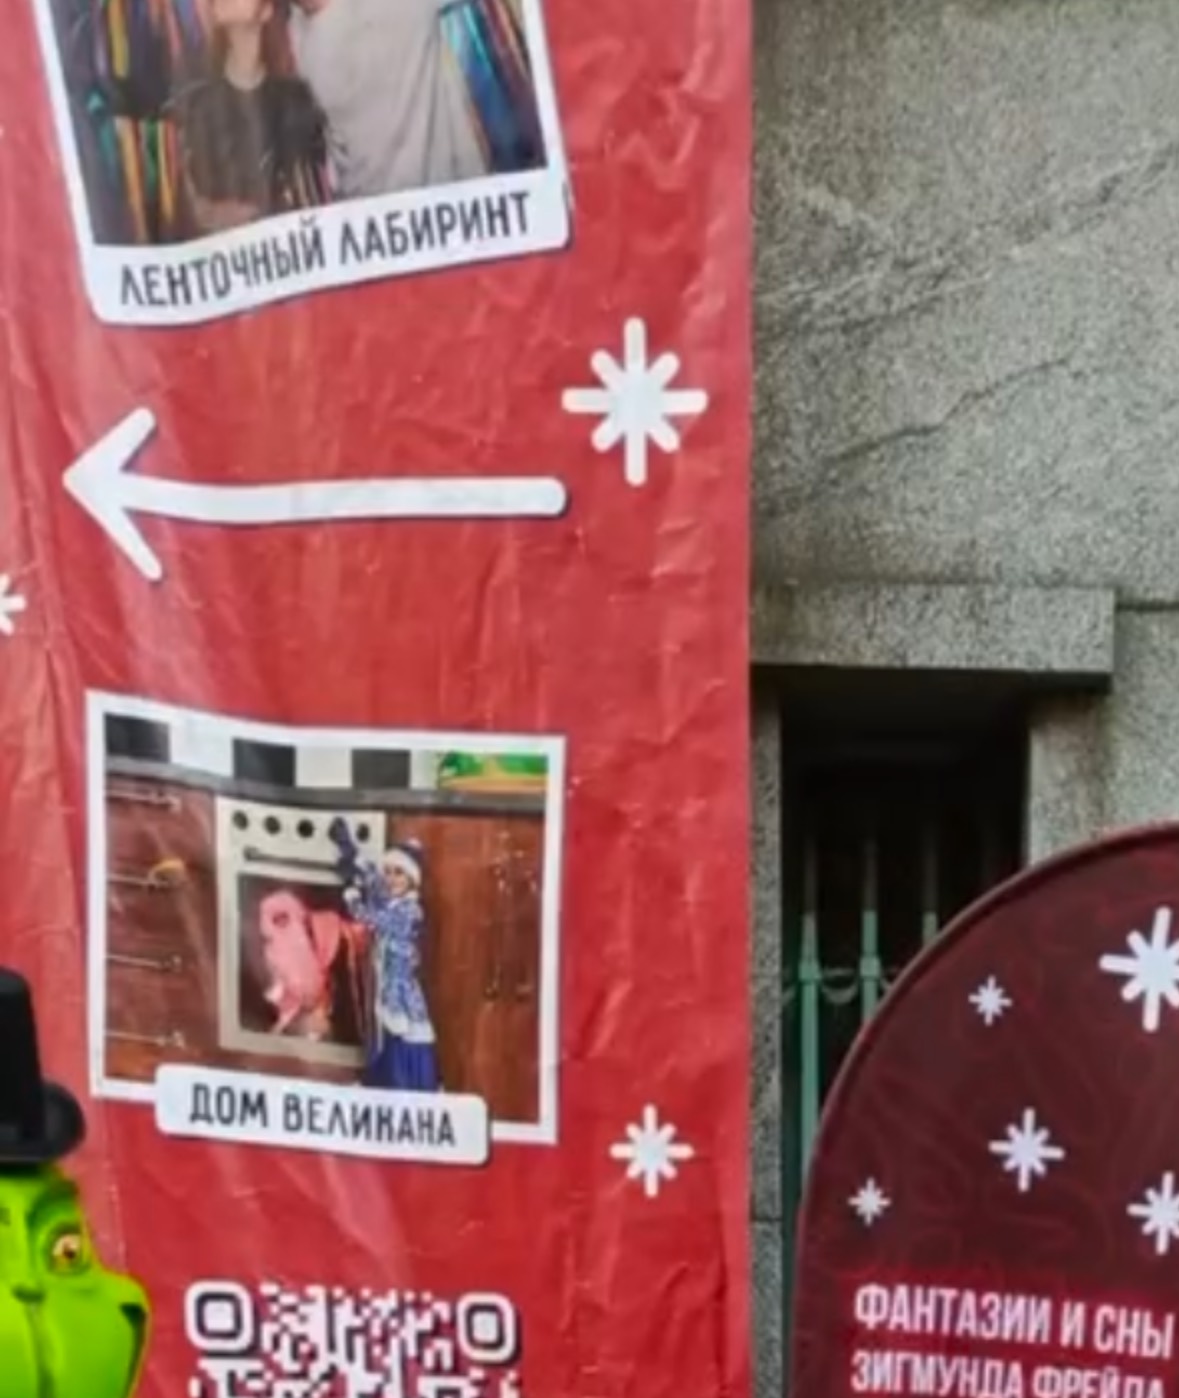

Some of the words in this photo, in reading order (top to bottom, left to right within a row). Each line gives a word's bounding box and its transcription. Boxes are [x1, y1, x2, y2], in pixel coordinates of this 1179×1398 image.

[119, 215, 327, 307] ЛЕНТОЧНЫЙ
[338, 192, 531, 266] ЛАБИРИНТ
[189, 1082, 269, 1128] ДОМ
[282, 1093, 456, 1147] ВЕЛИКАНА
[854, 1282, 1052, 1345] ФАНТАЗИИ
[1059, 1300, 1087, 1349] И
[1093, 1304, 1176, 1361] СНЫ
